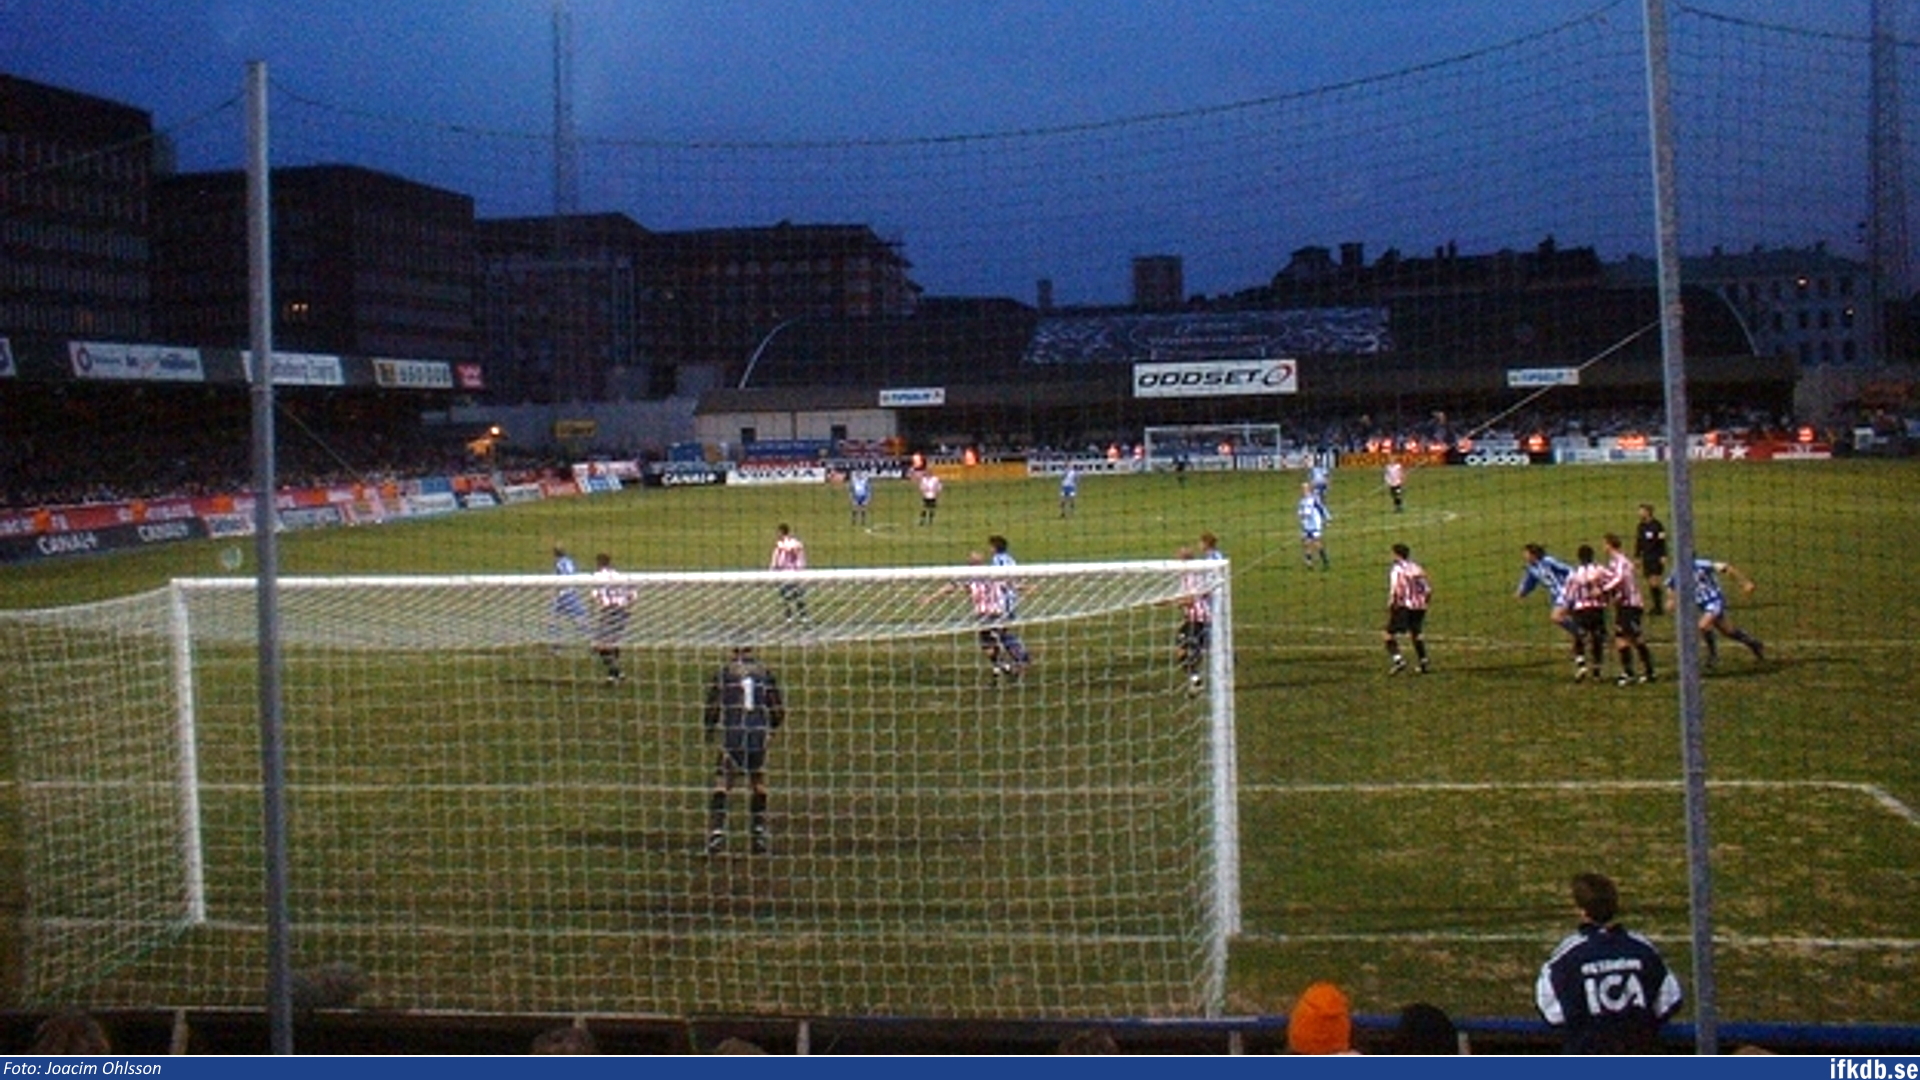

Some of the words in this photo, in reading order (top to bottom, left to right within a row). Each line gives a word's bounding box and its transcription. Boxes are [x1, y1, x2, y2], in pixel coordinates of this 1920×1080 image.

[1138, 368, 1263, 388] ODDSET
[741, 677, 754, 711] 1
[1584, 972, 1646, 1015] ICA
